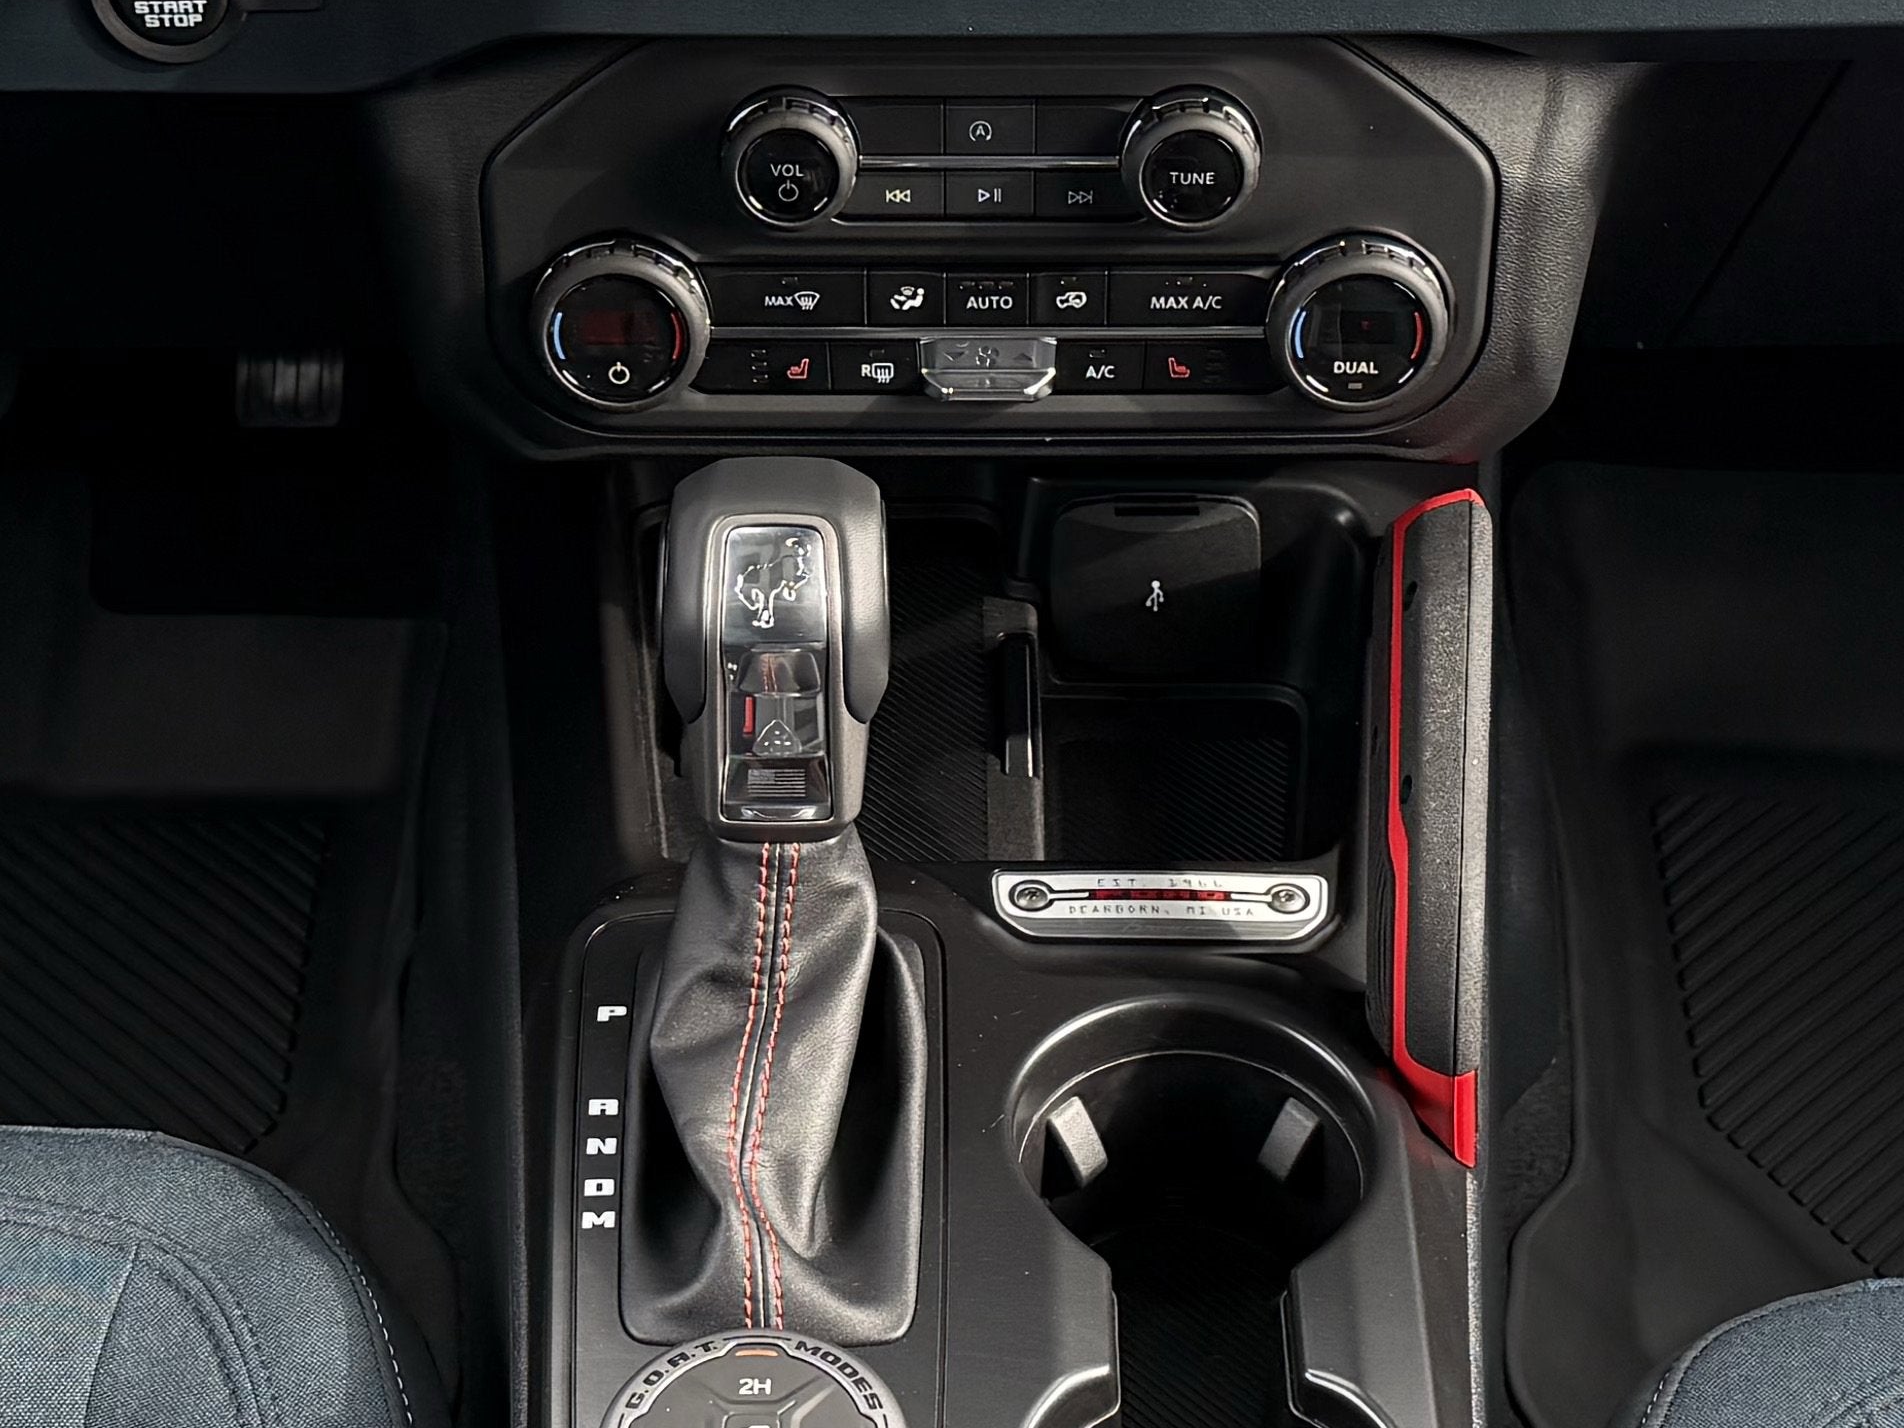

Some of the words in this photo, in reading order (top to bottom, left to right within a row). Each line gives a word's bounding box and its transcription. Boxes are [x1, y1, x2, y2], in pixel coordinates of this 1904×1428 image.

[134, 0, 208, 14] START
[144, 13, 203, 28] STOP
[770, 163, 805, 179] VOL
[1168, 171, 1216, 186] TUNE
[764, 294, 795, 307] MAX
[965, 295, 1014, 310] AUTO
[1150, 295, 1189, 310] MAX
[1192, 295, 1223, 310] A/C
[860, 364, 871, 377] R
[1085, 365, 1115, 379] A/C
[1332, 360, 1380, 375] DUAL
[1096, 877, 1146, 889] EST.
[1068, 904, 1169, 916] DEARBORN,
[1221, 907, 1254, 917] USA
[596, 1005, 628, 1022] P
[588, 1098, 619, 1116] R
[586, 1137, 618, 1155] N
[583, 1178, 615, 1197] D
[581, 1211, 616, 1229] M
[625, 1339, 719, 1410] G.O.A.T.
[794, 1339, 884, 1411] MODES
[738, 1378, 772, 1396] 2H
